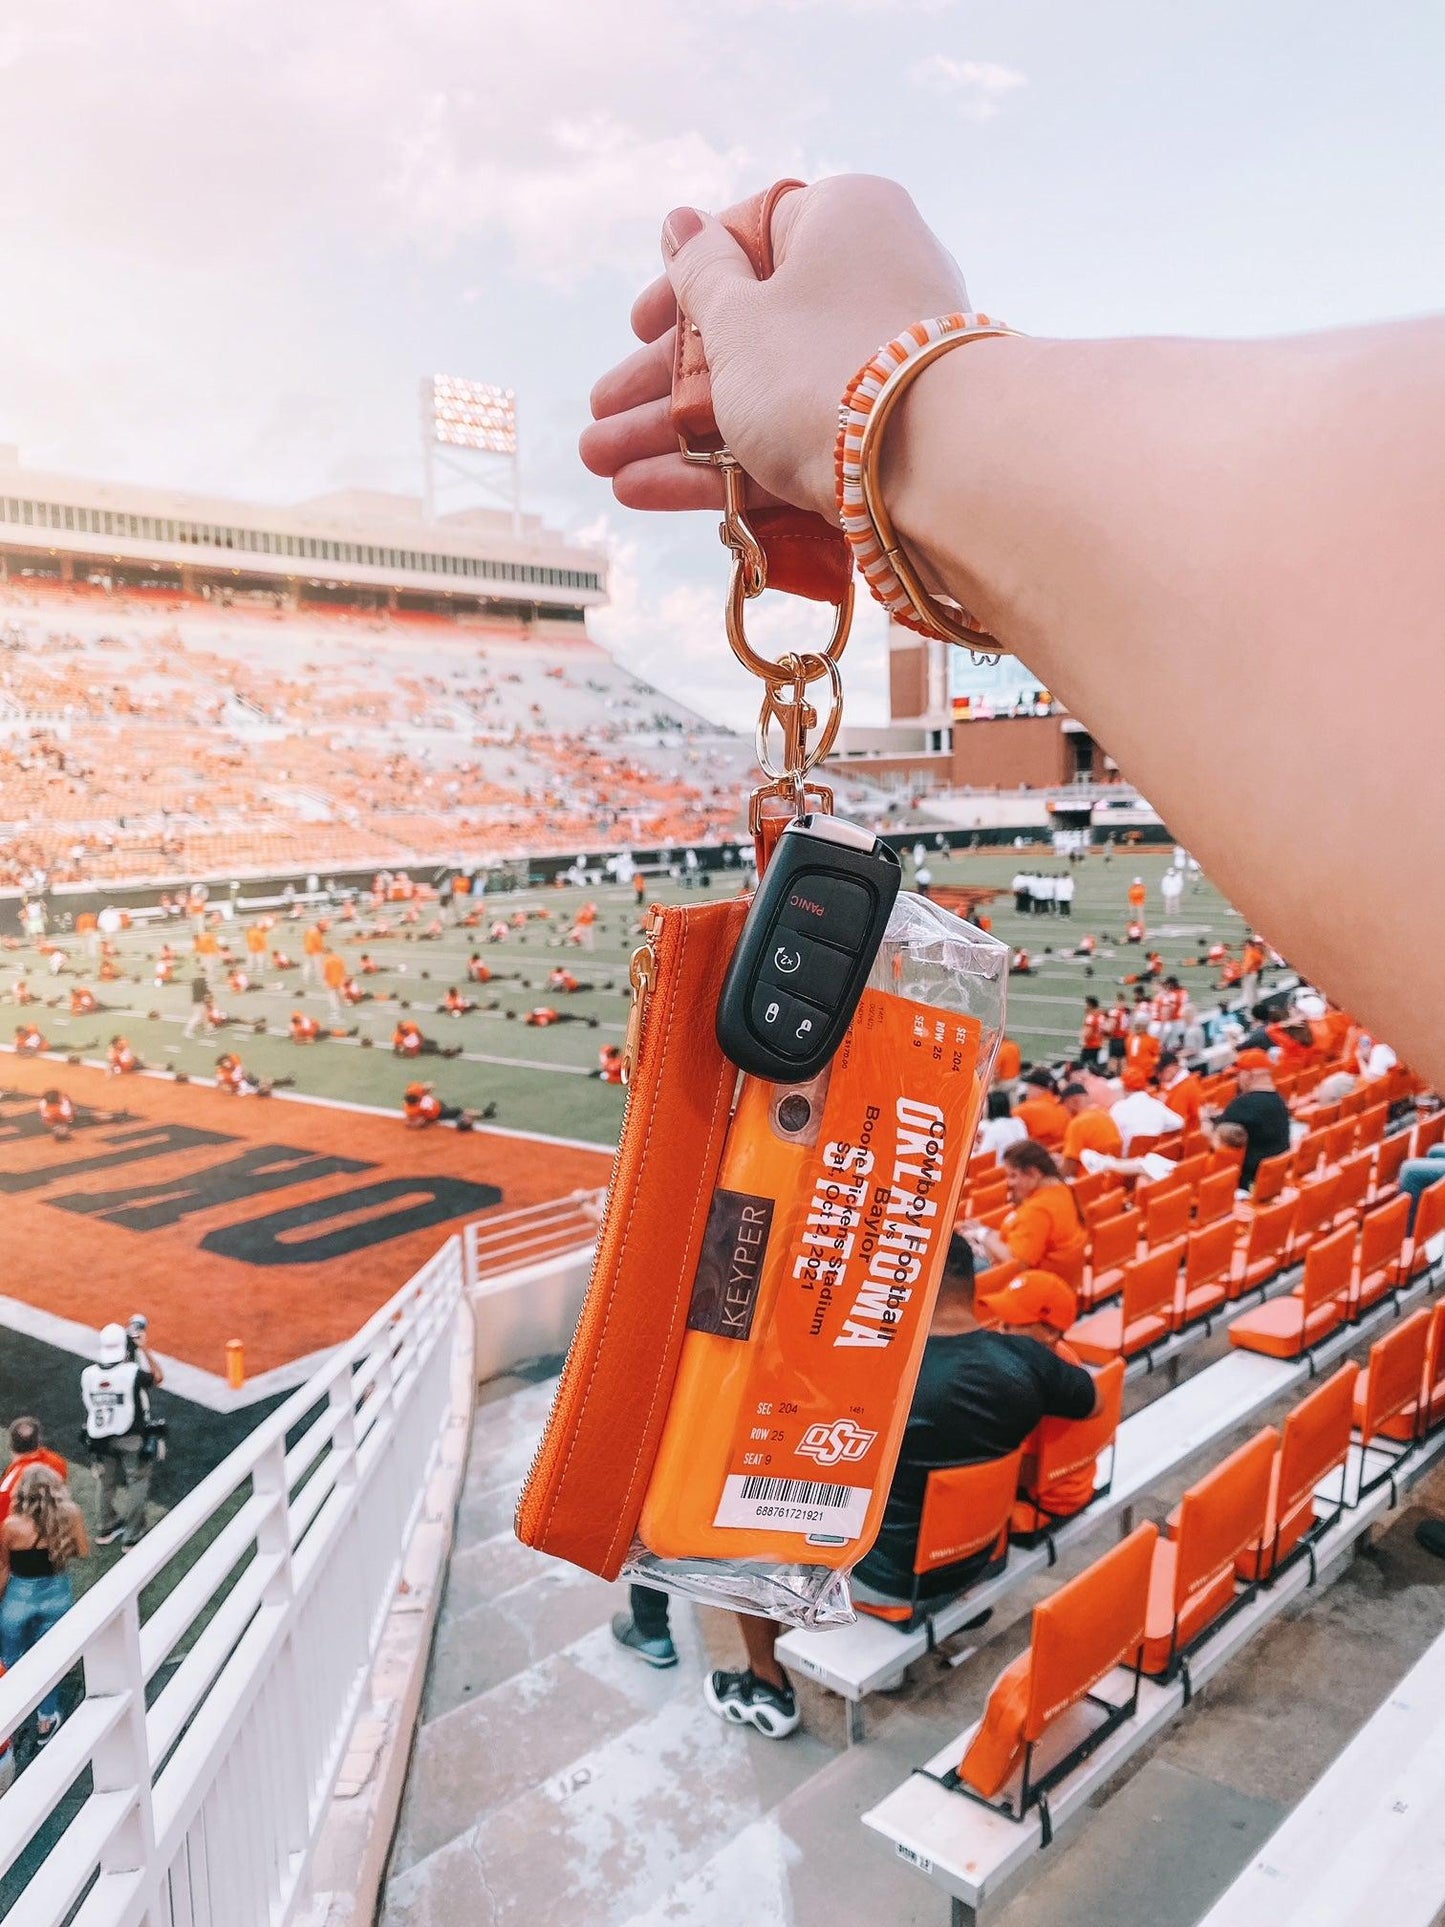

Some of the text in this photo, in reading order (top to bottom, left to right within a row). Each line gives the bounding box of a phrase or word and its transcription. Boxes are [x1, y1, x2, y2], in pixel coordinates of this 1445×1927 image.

[789, 895, 825, 917] PANIC
[913, 1014, 925, 1048] SEAT 9
[932, 1020, 946, 1061] ROW 25
[951, 1026, 967, 1072] SEC 204
[792, 1140, 875, 1287] STATE
[801, 1140, 850, 1291] Sat, Oct 2, 2021
[810, 1105, 881, 1336] Boone Pickens Stadium
[833, 1096, 944, 1348] OKLAHOMA
[858, 1187, 892, 1263] Baylor
[877, 1120, 947, 1342] Cowboy Football
[885, 1223, 898, 1240] vs
[721, 1206, 766, 1327] KEYPER
[757, 1402, 798, 1415] SEC 204
[750, 1427, 785, 1442] ROW 25
[794, 1418, 879, 1467] OSU
[743, 1452, 772, 1465] SEAT 9
[755, 1505, 824, 1521] 688761721921
